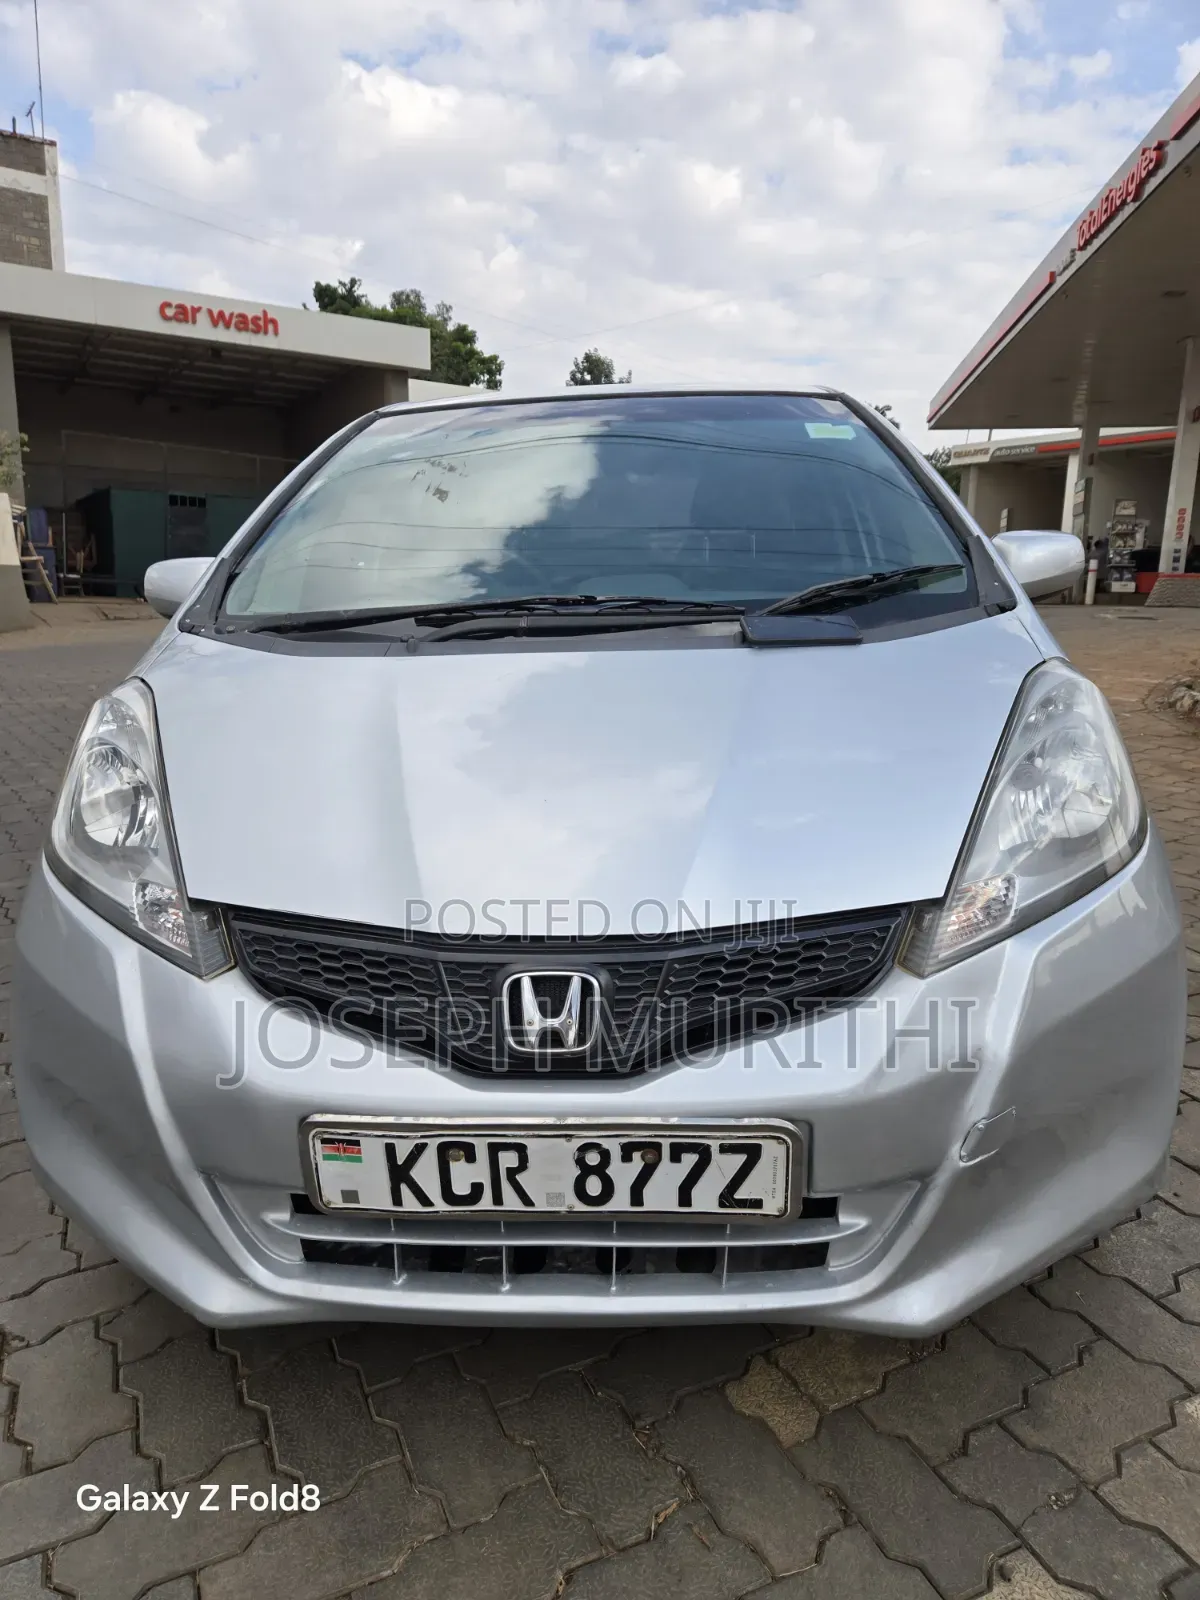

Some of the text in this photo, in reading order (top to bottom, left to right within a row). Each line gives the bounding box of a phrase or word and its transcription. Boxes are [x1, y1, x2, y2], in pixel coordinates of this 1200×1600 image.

[1076, 140, 1168, 251] TotalEnergies
[159, 300, 279, 337] car wash
[384, 1140, 536, 1208] KCR
[573, 1140, 764, 1209] 877Z
